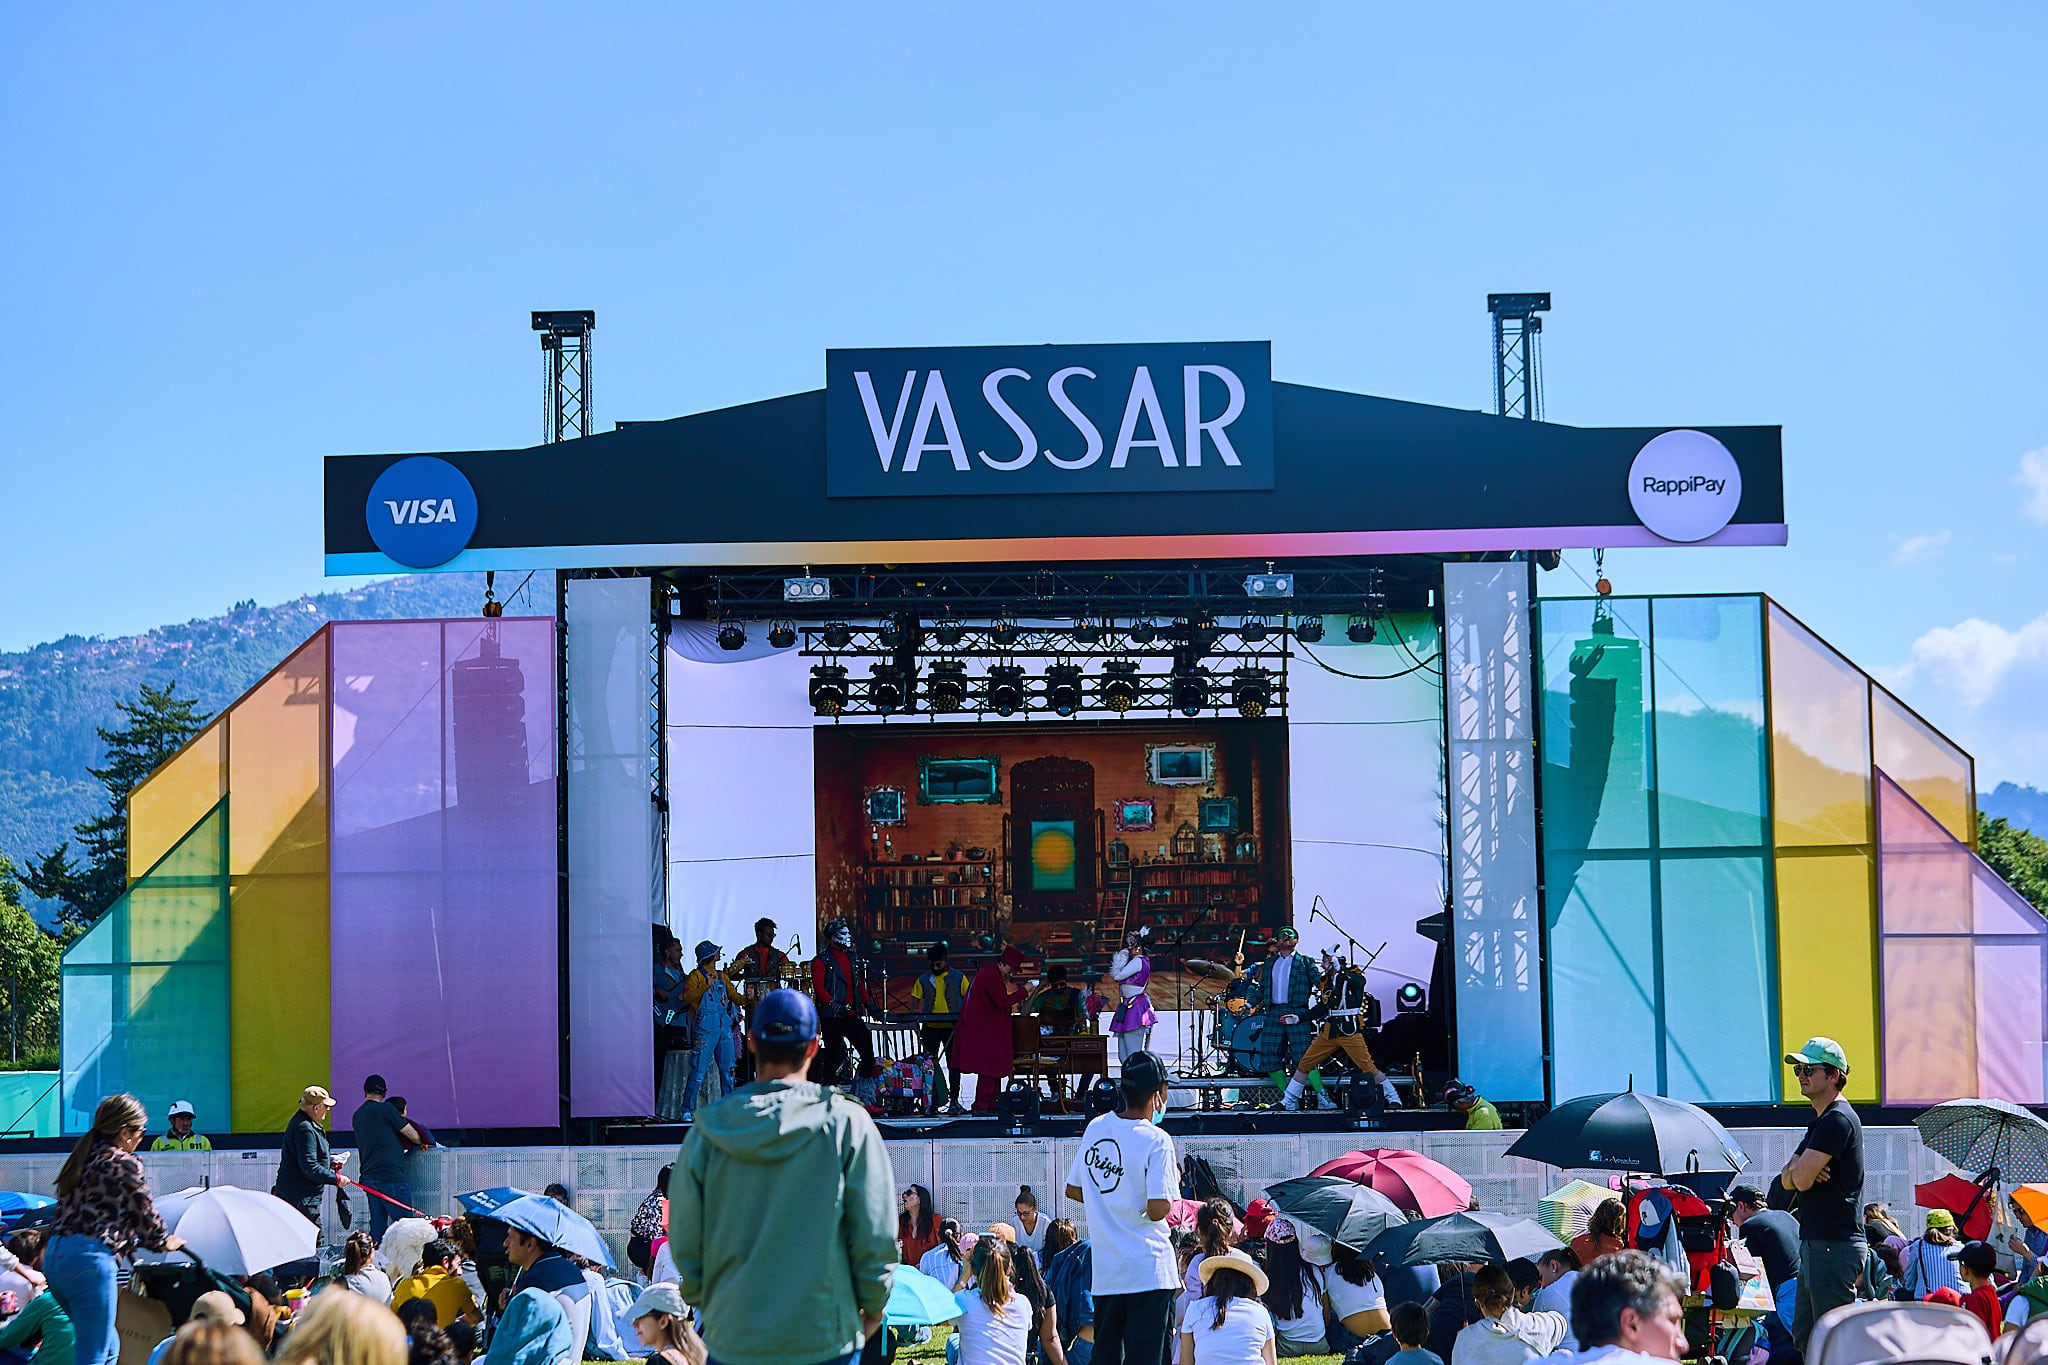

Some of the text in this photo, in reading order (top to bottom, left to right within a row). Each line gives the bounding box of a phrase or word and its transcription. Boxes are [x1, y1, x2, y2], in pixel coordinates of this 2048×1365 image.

[853, 365, 1246, 472] VASSAR
[1643, 476, 1726, 495] RappiPay
[383, 498, 457, 525] VISA
[1085, 1147, 1124, 1178] Origen
